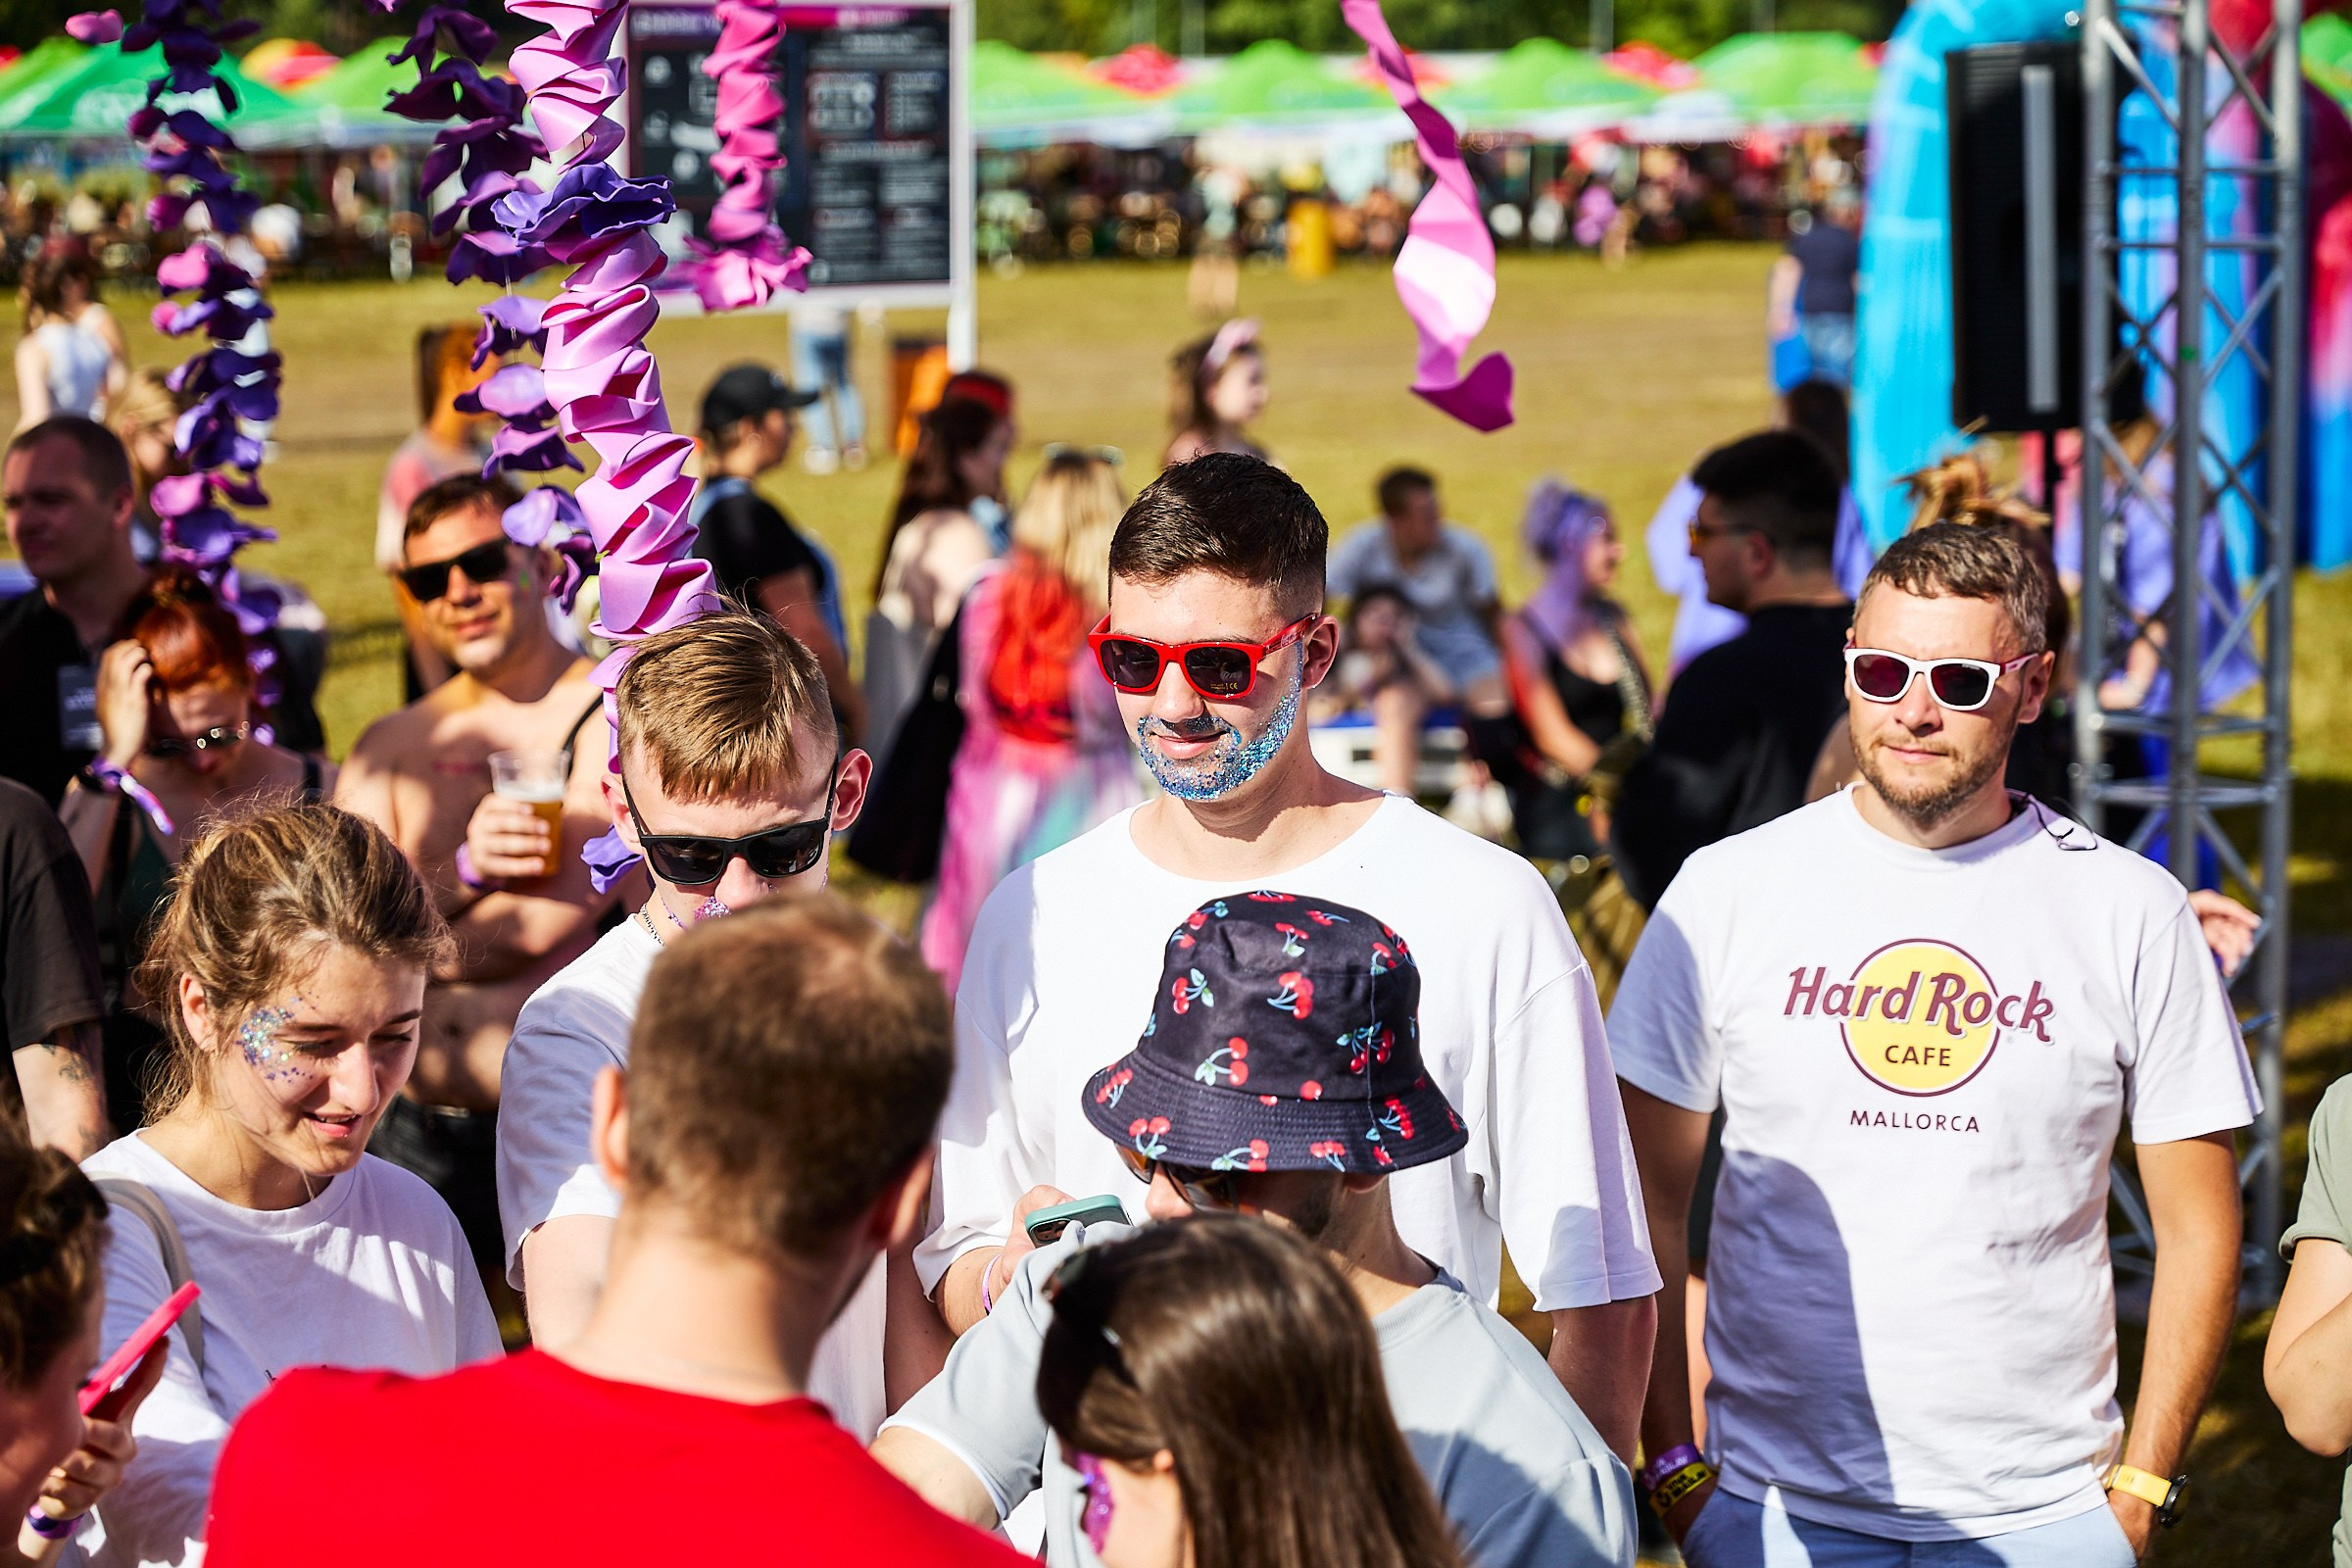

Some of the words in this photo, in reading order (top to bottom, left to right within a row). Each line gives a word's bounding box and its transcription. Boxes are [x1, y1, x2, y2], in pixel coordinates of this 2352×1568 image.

[1784, 966, 1923, 1021] Hard
[1925, 972, 2054, 1043] Rock
[1885, 1045, 1951, 1067] CAFE
[1850, 1110, 1980, 1133] MALLORCA
